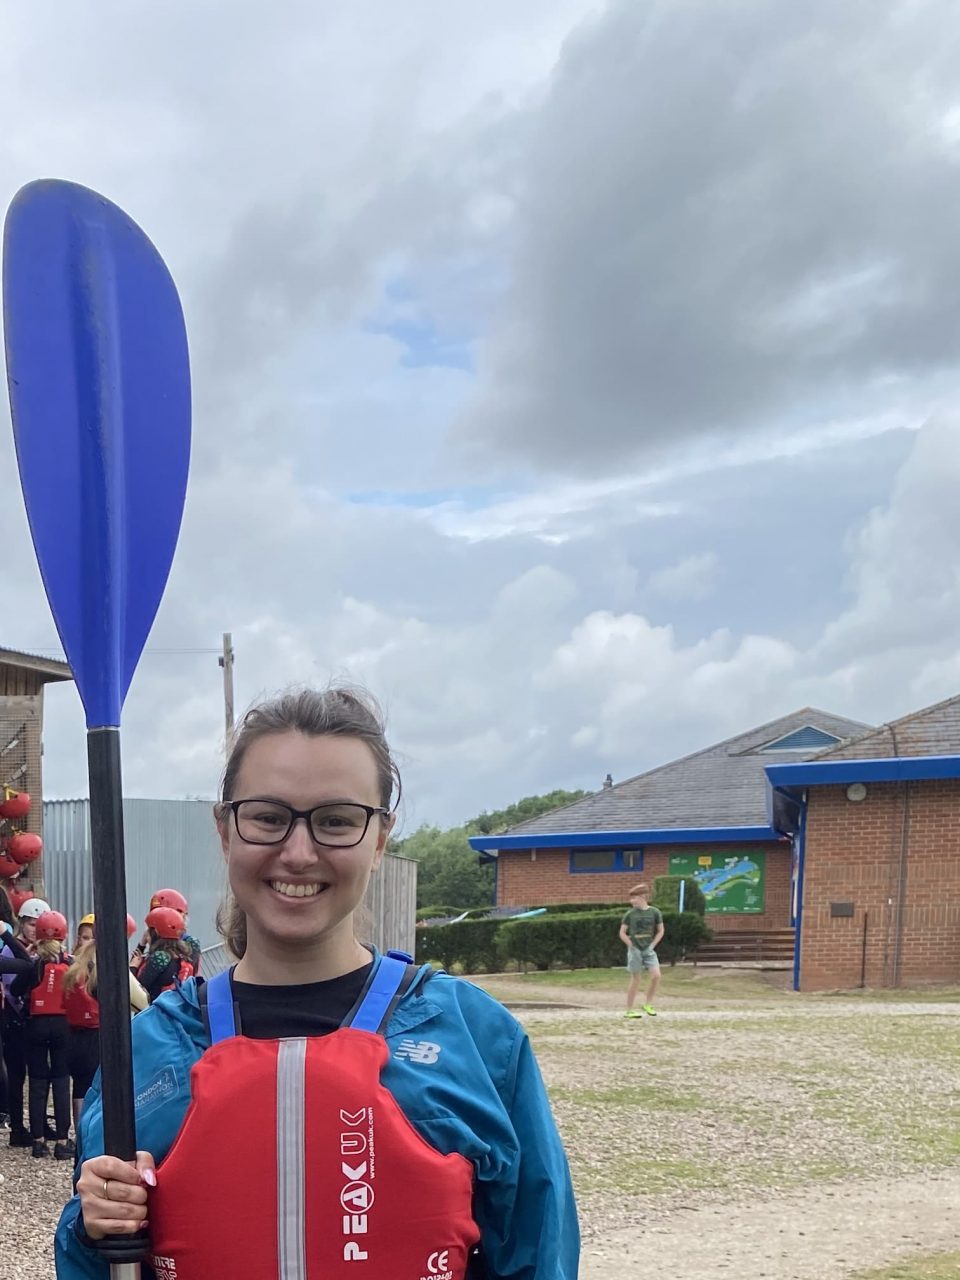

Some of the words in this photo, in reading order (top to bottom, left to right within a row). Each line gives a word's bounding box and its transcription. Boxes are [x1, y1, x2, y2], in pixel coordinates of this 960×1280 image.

[340, 1107, 367, 1155] UK
[367, 1106, 376, 1180] www.peakuk.com
[341, 1160, 374, 1261] PEAK
[427, 1250, 449, 1274] CE
